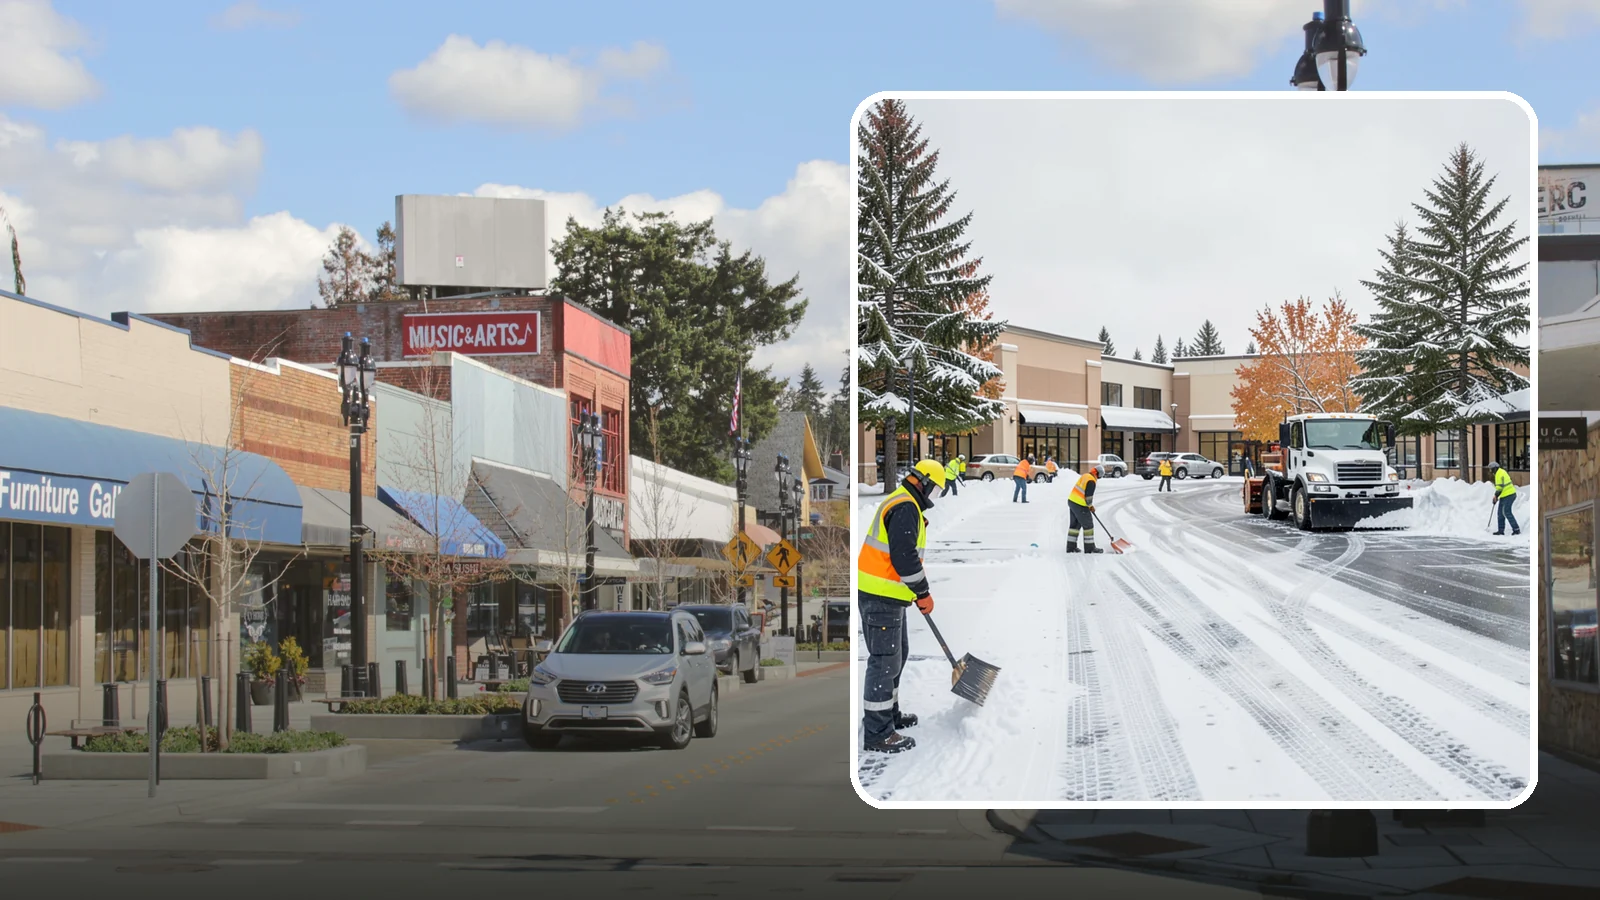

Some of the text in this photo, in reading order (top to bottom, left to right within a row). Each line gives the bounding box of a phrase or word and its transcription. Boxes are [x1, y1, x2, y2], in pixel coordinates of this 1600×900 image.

[409, 323, 519, 348] MUSIC&ARTS
[1540, 428, 1577, 437] UGA
[0, 471, 121, 519] Furniture Gal
[453, 563, 479, 574] SUSHI
